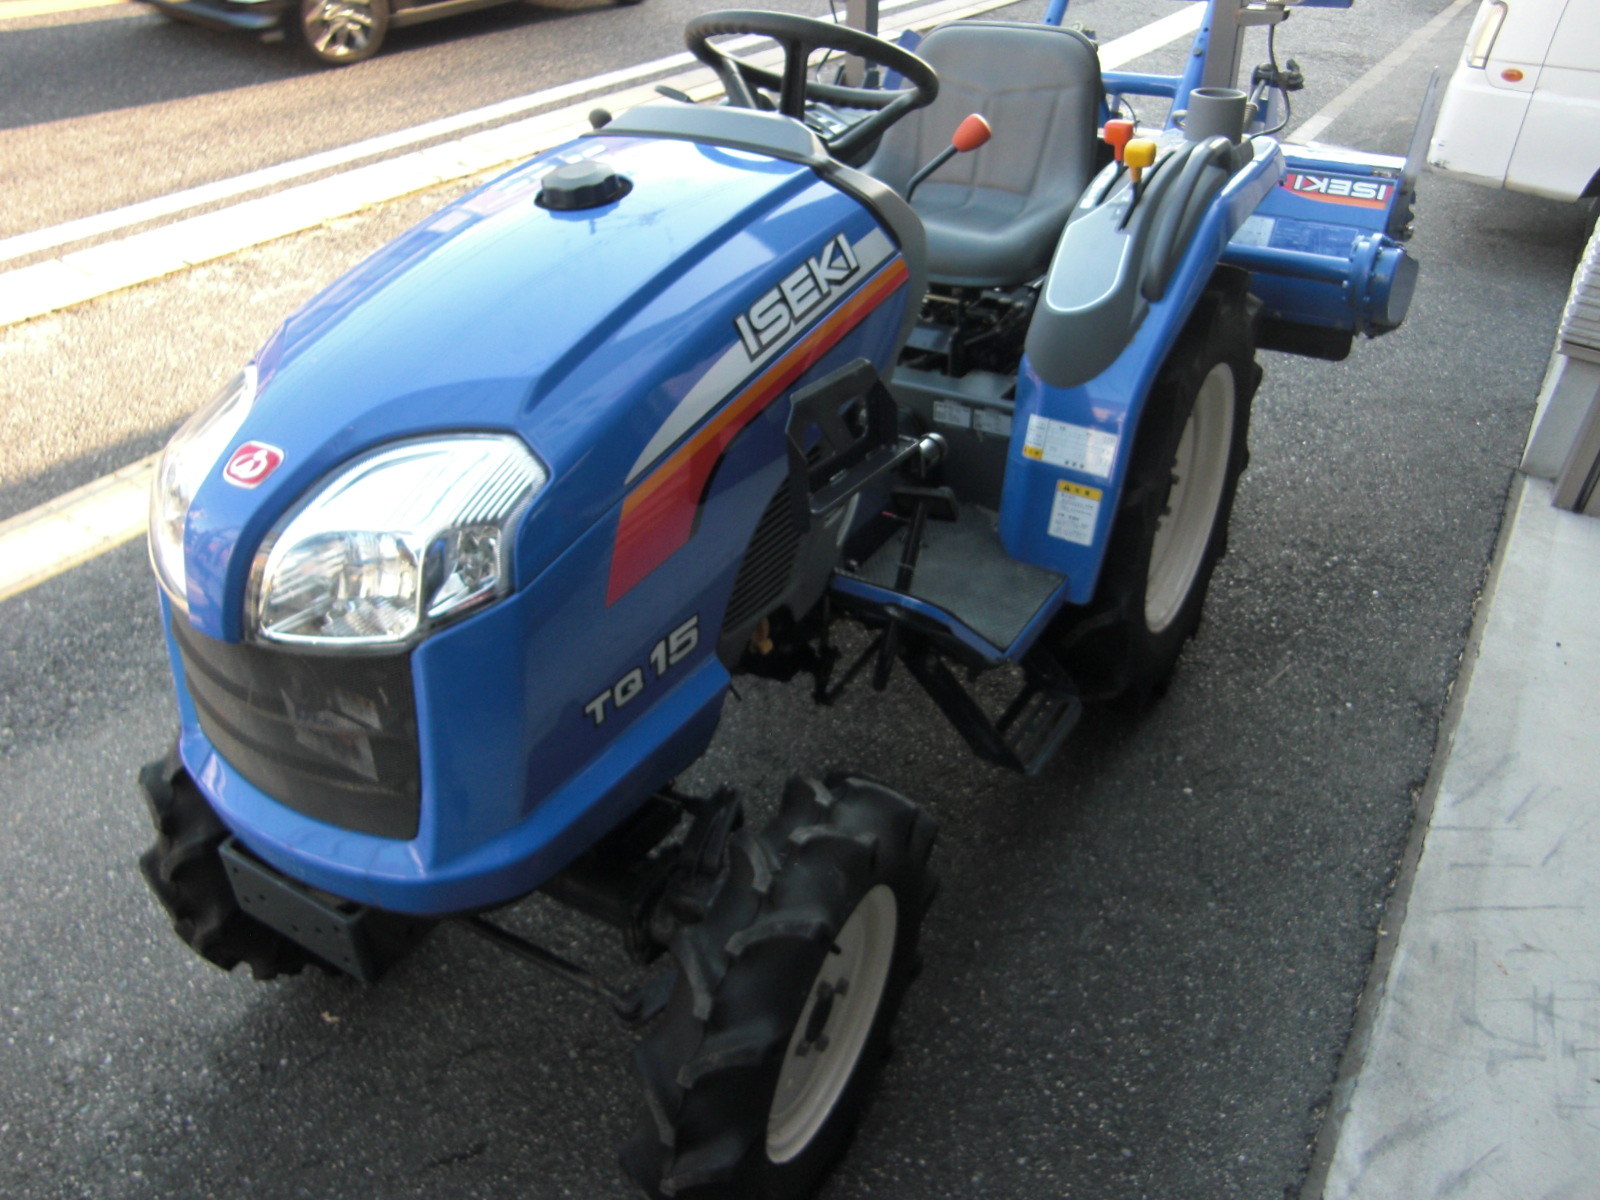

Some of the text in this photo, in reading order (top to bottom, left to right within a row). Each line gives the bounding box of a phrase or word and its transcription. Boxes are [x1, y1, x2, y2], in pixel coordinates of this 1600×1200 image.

[1293, 174, 1387, 201] ISEKI
[735, 232, 860, 361] ISEKI
[585, 615, 698, 724] TQ 15
